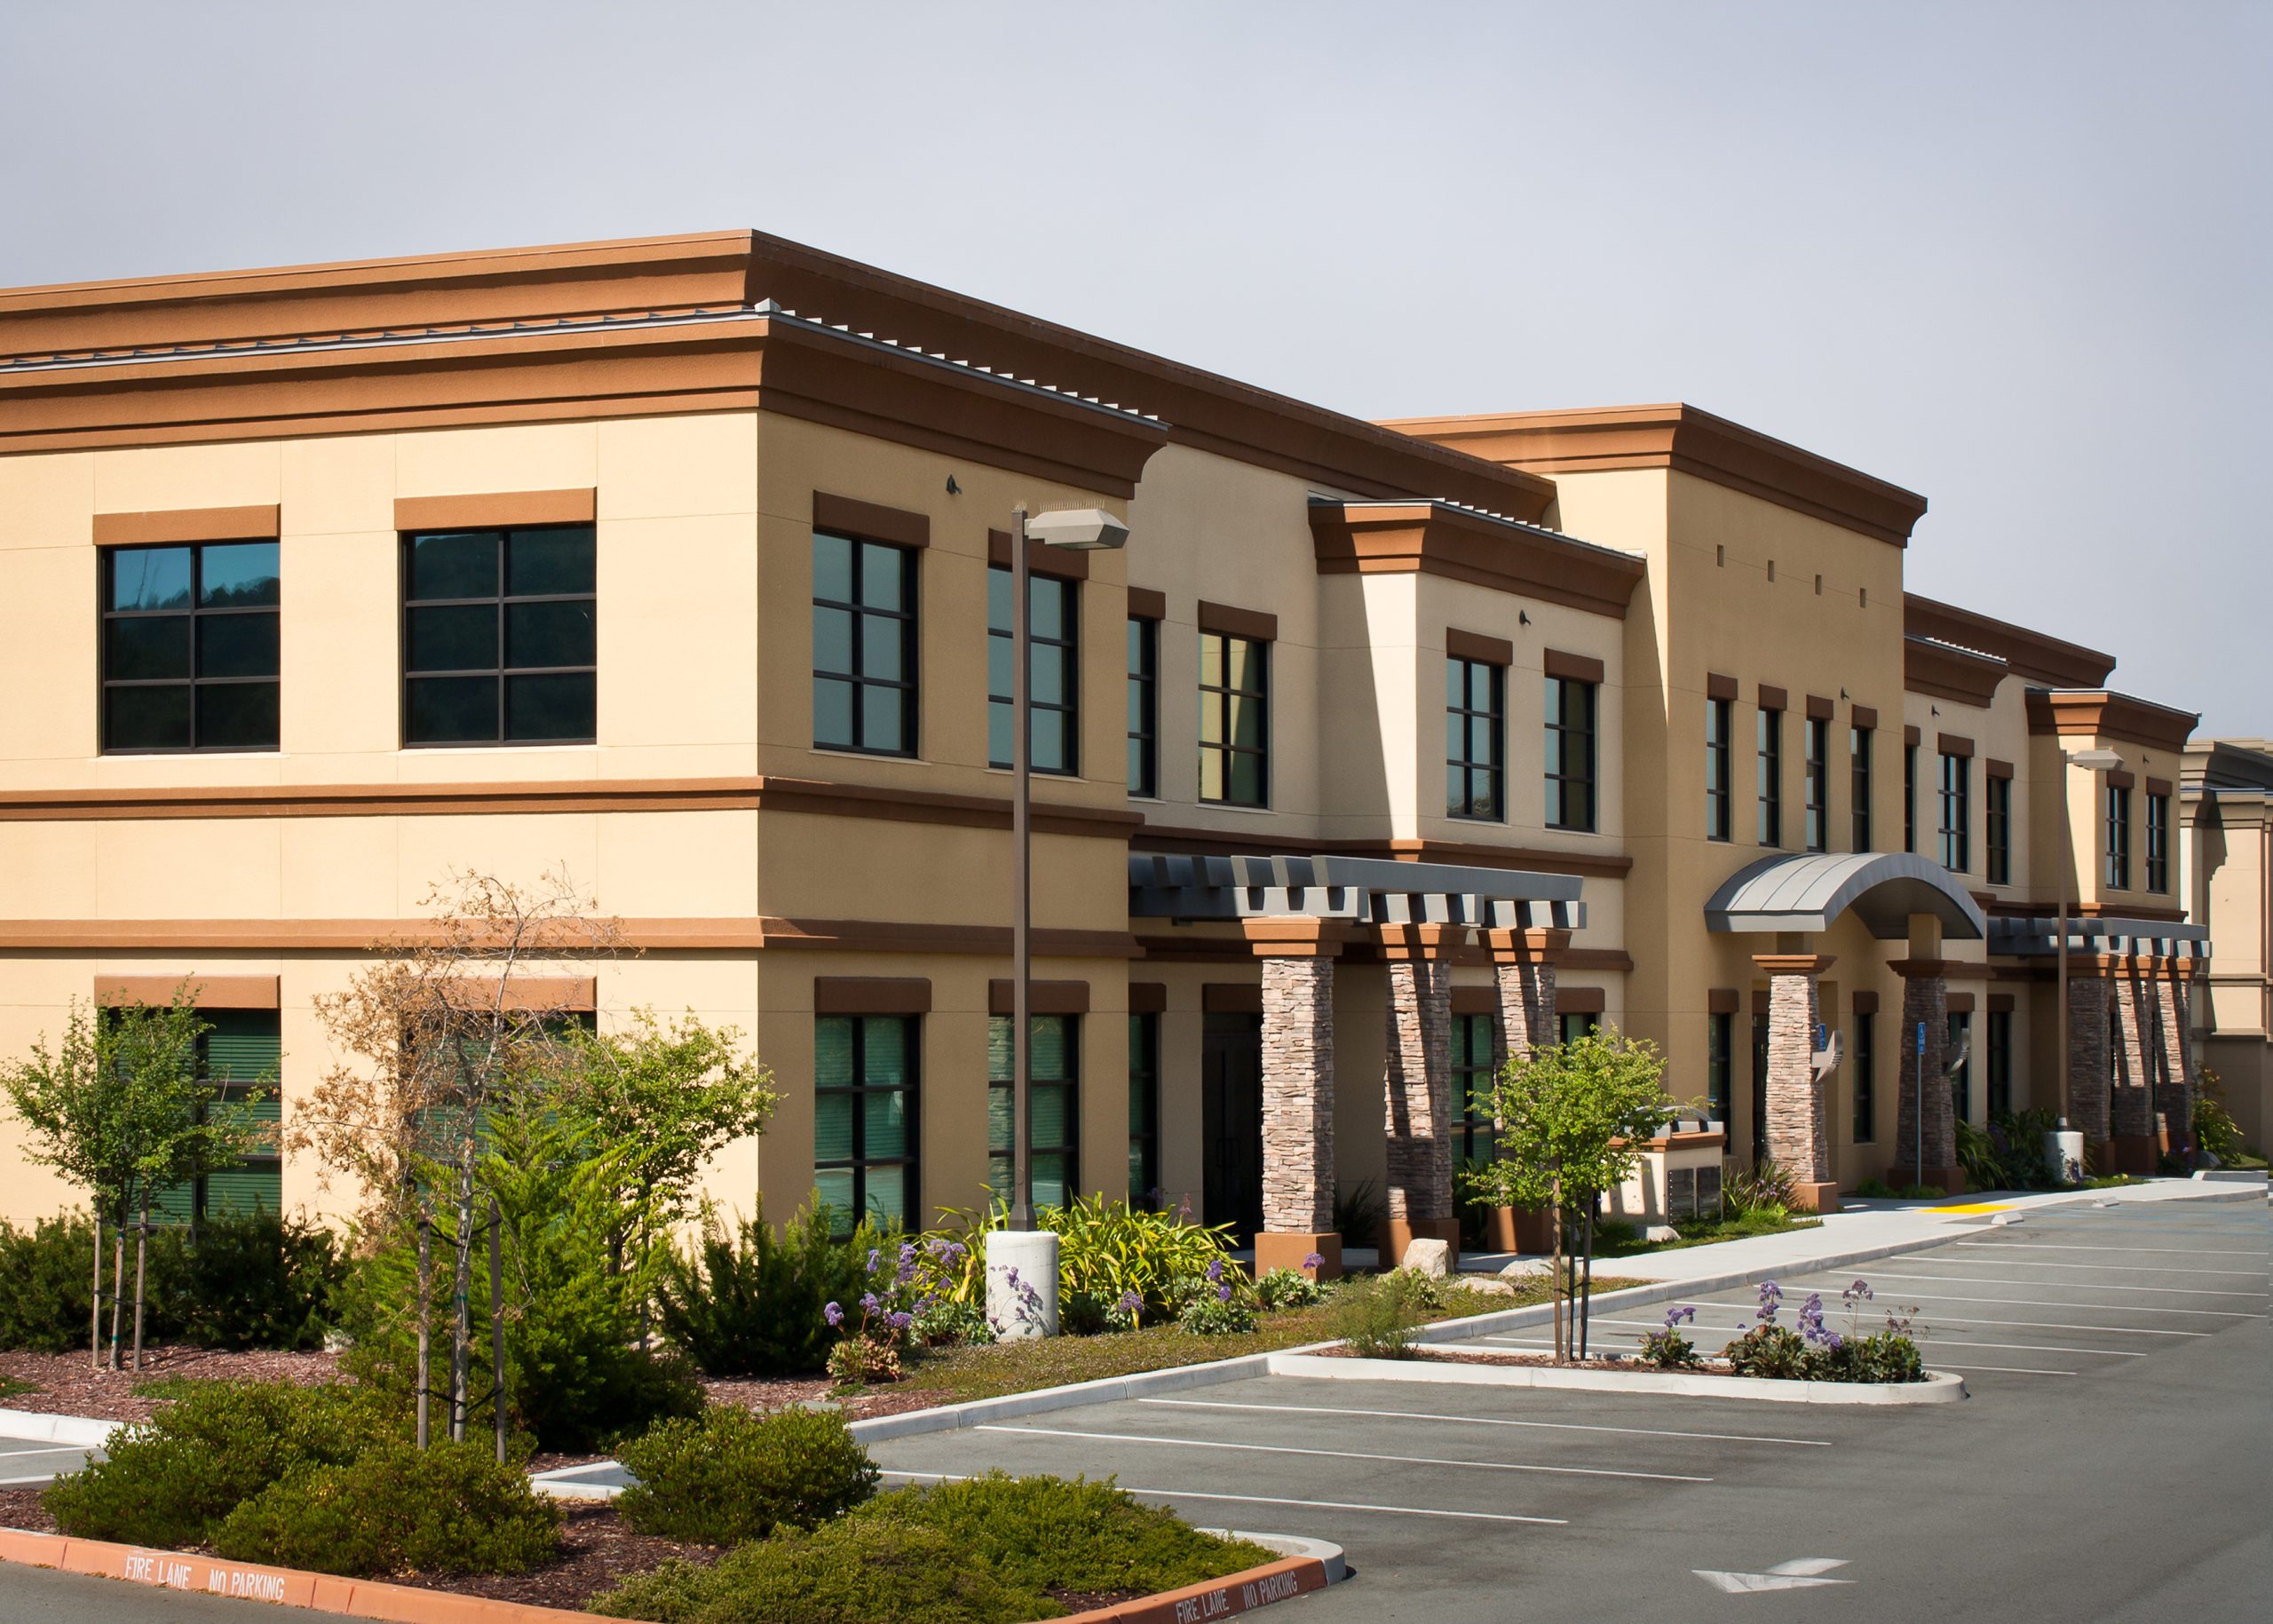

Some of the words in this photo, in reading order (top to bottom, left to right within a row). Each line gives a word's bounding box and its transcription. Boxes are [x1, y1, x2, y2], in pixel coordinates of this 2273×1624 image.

[125, 1556, 154, 1580] FIRE
[158, 1560, 192, 1590] LANE
[209, 1569, 227, 1593] NO
[231, 1572, 285, 1600] PARKING
[1176, 1597, 1200, 1624] FIRE
[1201, 1588, 1230, 1617] LANE
[1242, 1584, 1258, 1609] NO
[1259, 1571, 1298, 1604] PARKING
